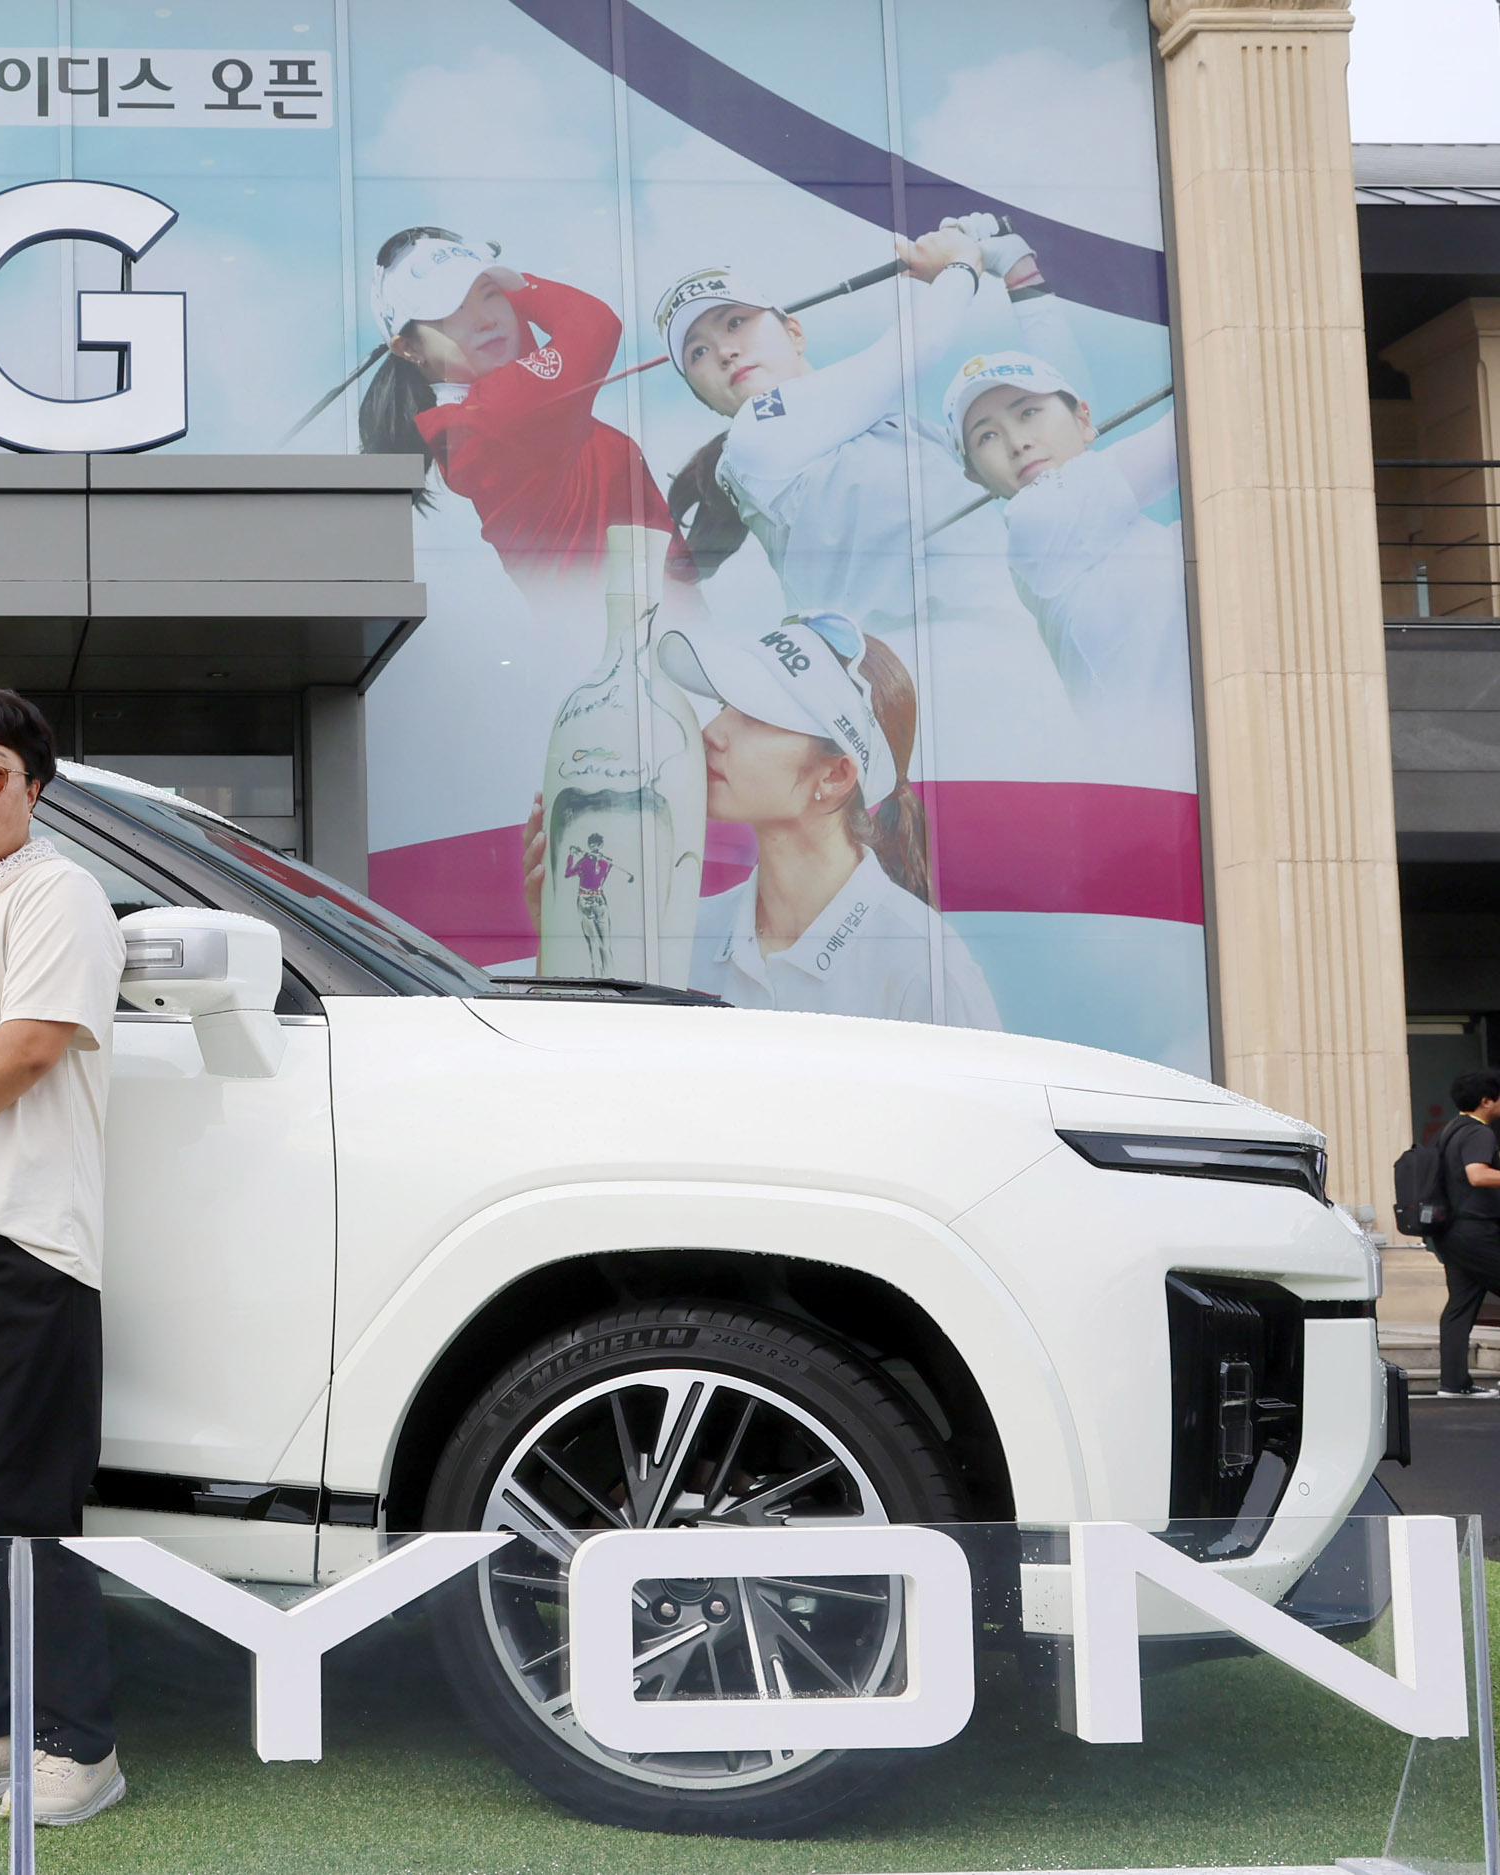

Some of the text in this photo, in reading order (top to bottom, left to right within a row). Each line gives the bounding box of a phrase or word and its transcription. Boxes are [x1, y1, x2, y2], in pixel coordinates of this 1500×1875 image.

[203, 58, 324, 120] 오픈
[826, 901, 870, 952] 메디컬오
[530, 1327, 799, 1389] MICHELIN 245/45 R 20
